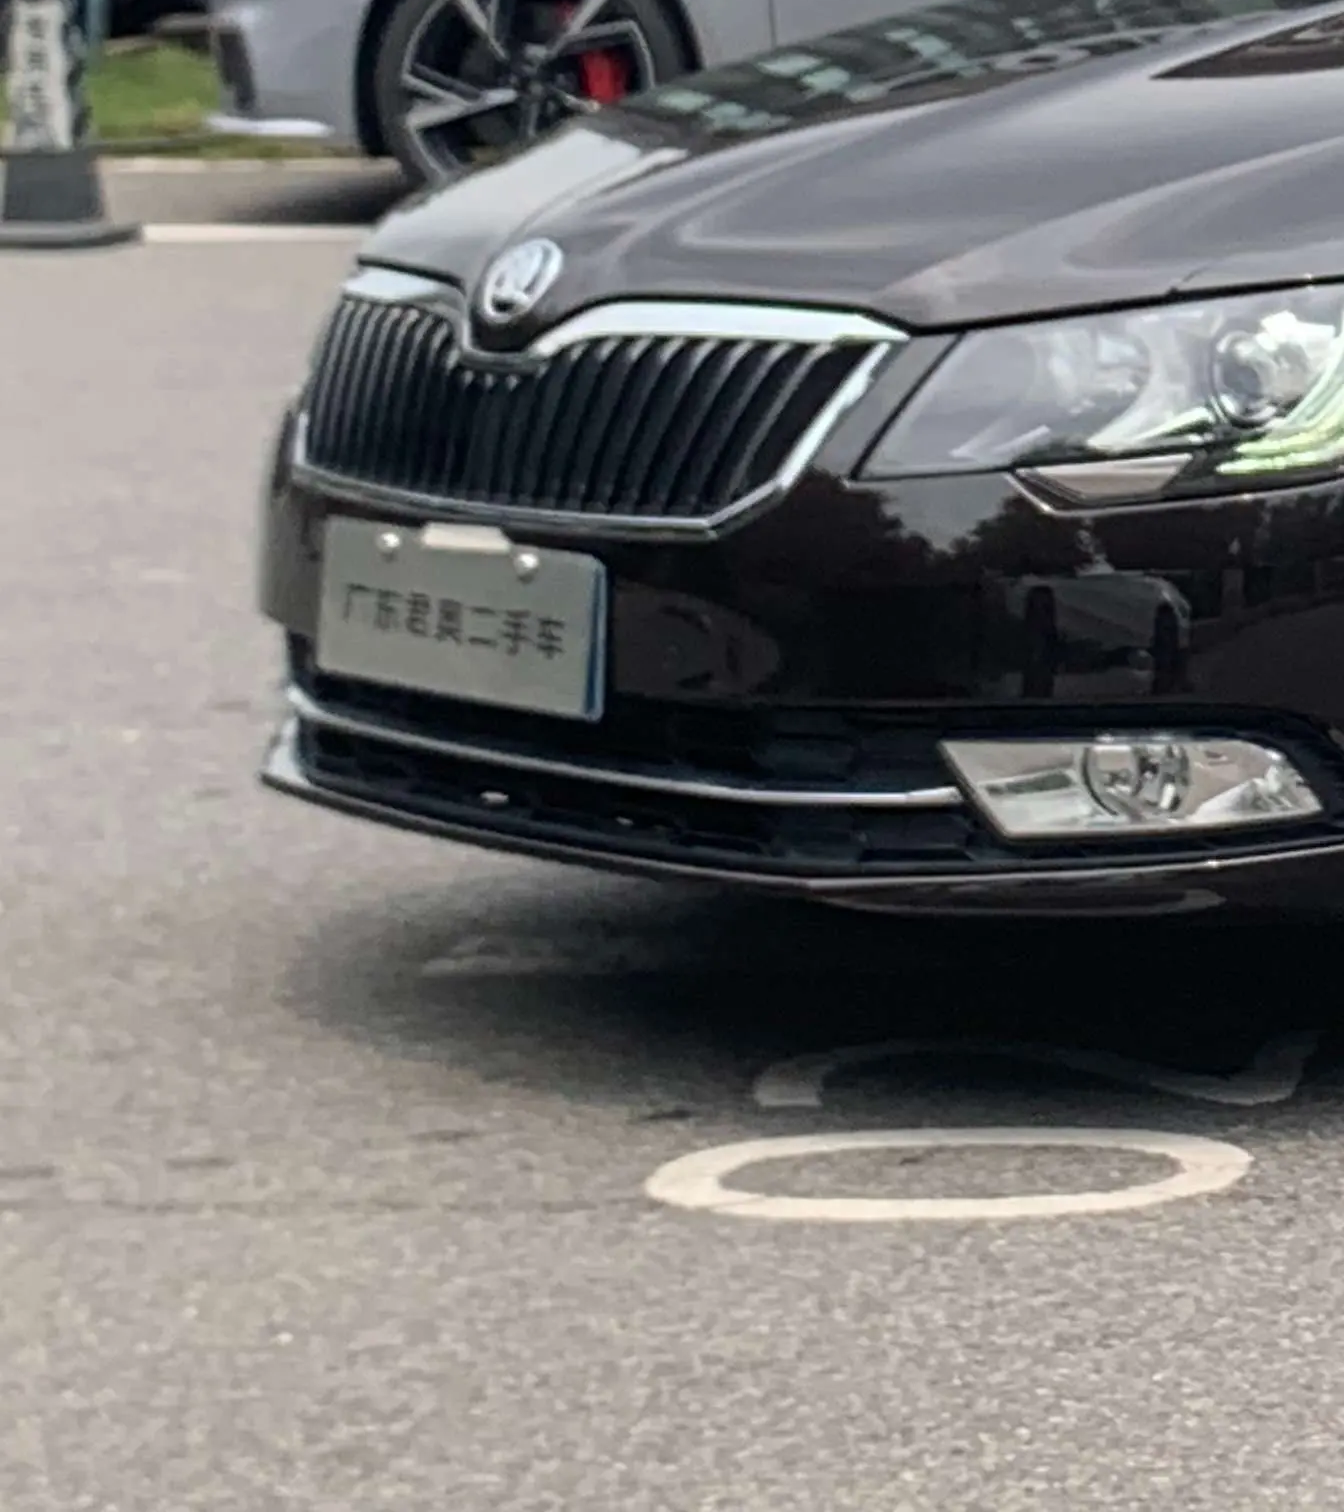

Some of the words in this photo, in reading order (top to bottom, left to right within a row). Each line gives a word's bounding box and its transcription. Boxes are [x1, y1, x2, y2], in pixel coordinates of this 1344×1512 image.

[342, 581, 566, 658] 广东君奥二手车
